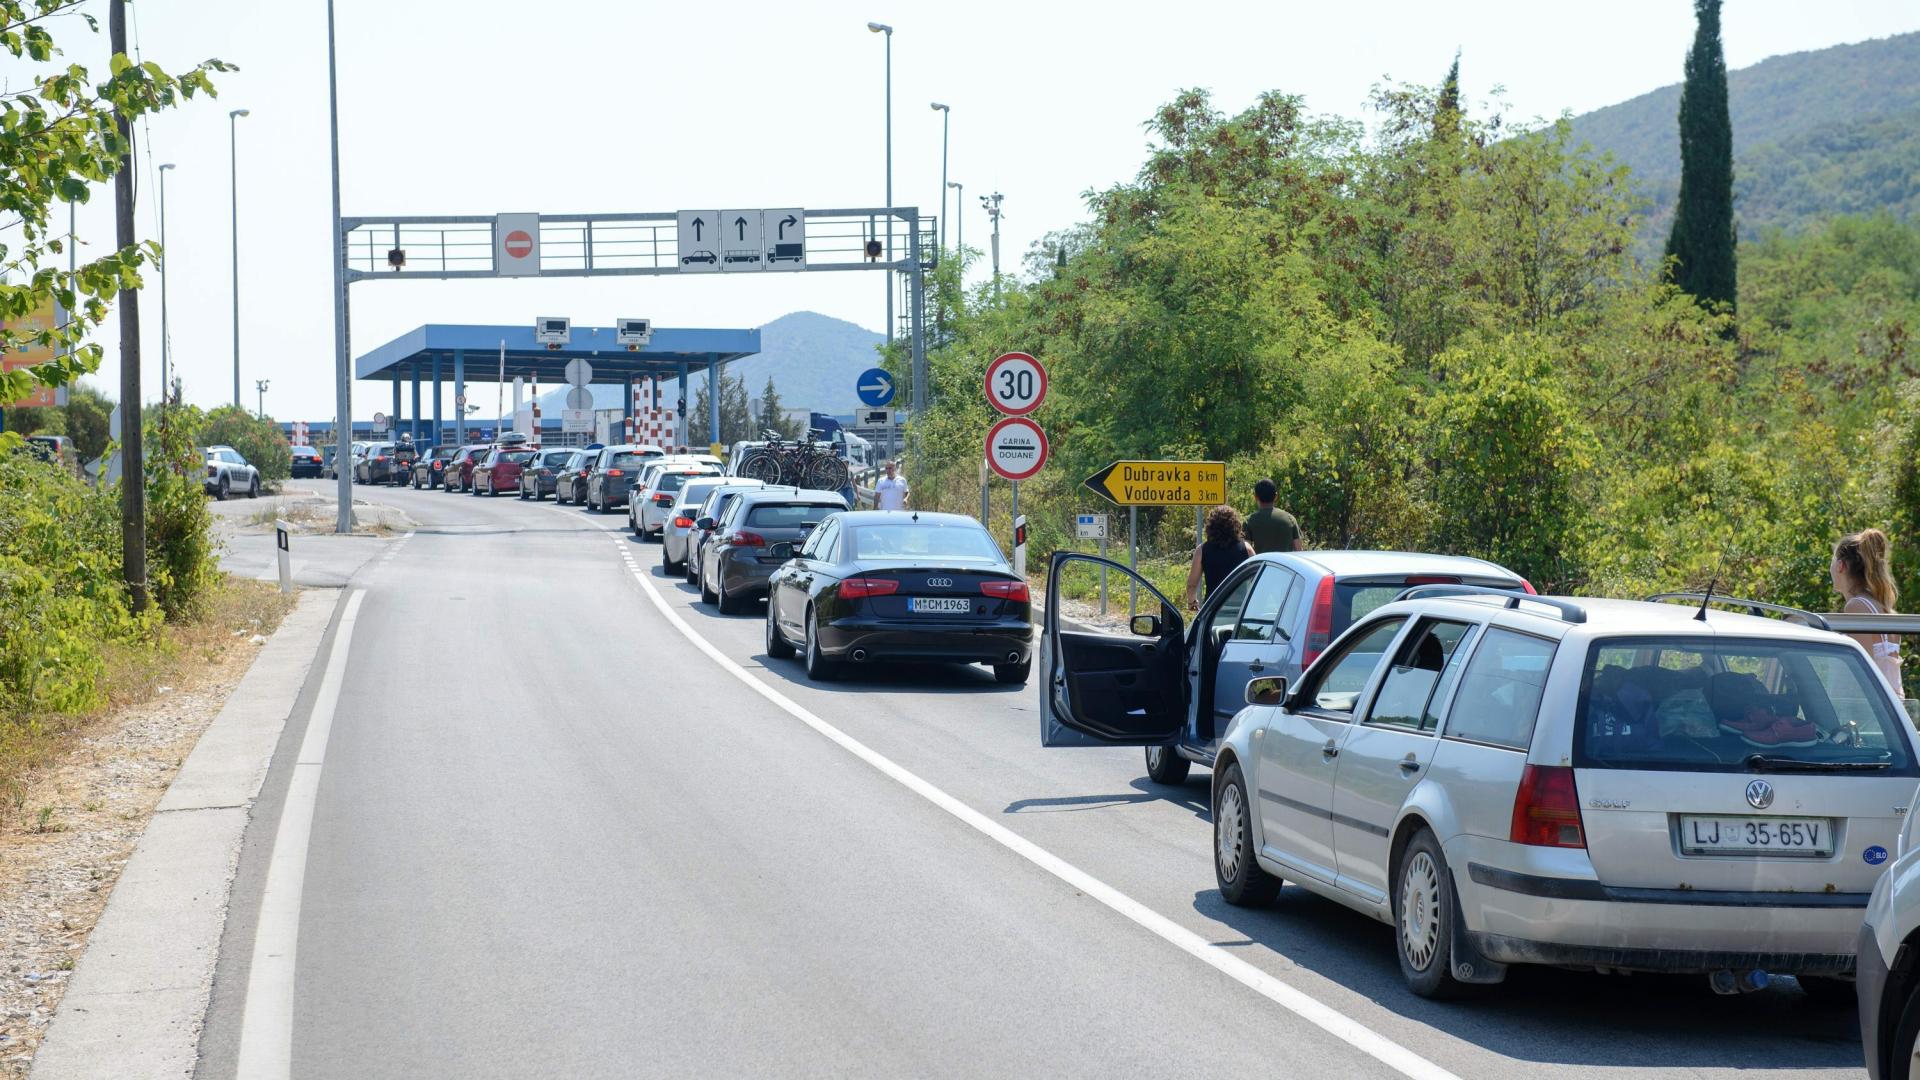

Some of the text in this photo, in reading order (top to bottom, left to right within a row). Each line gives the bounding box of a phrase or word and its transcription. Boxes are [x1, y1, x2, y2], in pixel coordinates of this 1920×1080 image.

[1000, 370, 1033, 400] 30
[999, 451, 1034, 459] DOUANE
[1124, 466, 1190, 481] Dubravka
[1098, 525, 1105, 537] 3
[1693, 821, 1720, 844] LJ
